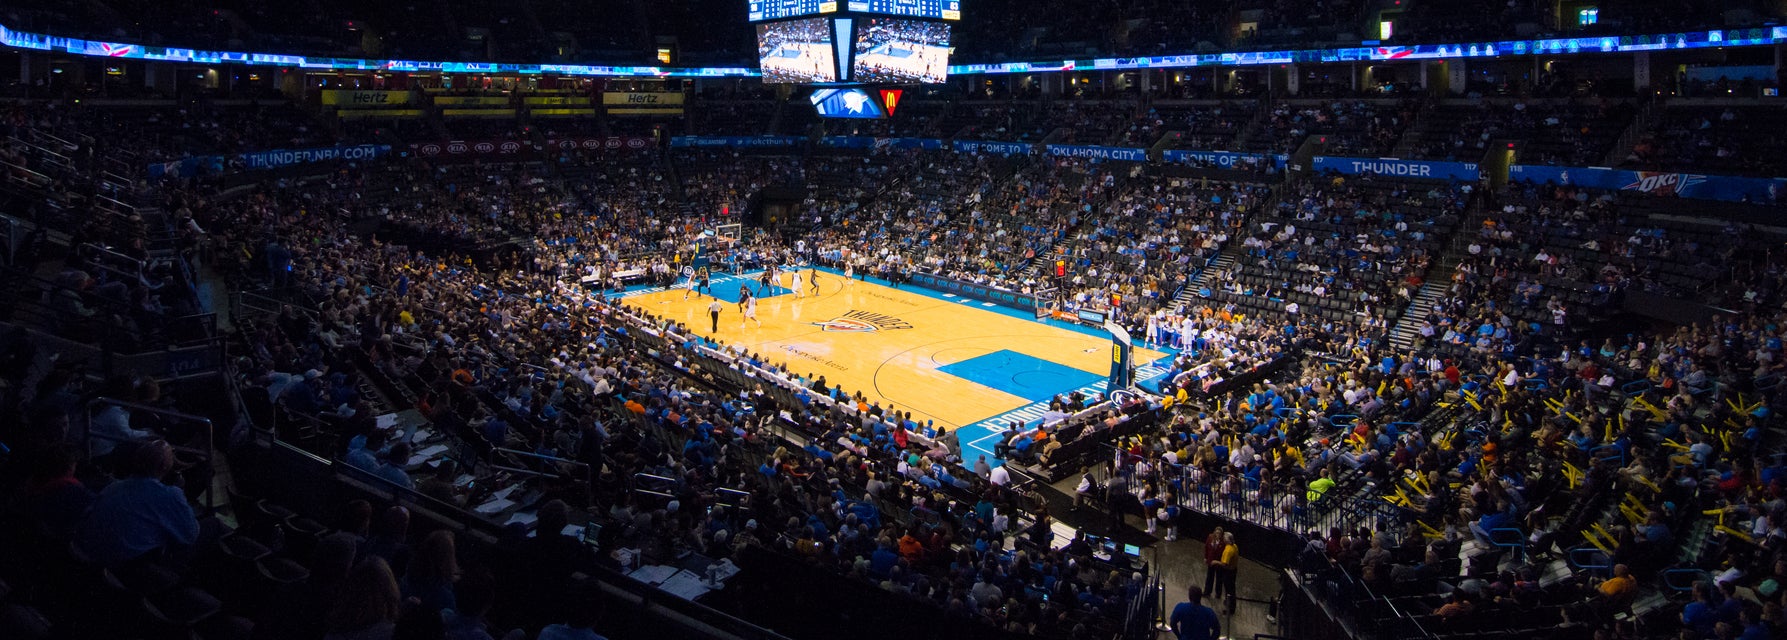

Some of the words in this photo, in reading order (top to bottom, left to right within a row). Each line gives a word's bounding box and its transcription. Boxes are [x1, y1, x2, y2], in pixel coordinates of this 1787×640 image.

[353, 92, 388, 103] Hertz
[627, 93, 658, 103] Hertz
[1008, 145, 1021, 153] TO
[1053, 147, 1109, 159] OKLAHOMA
[1112, 150, 1136, 160] CITY
[1219, 155, 1237, 166] OF
[1352, 161, 1431, 176] THUNDER
[1641, 173, 1676, 192] OKC
[842, 309, 914, 331] THUNDER
